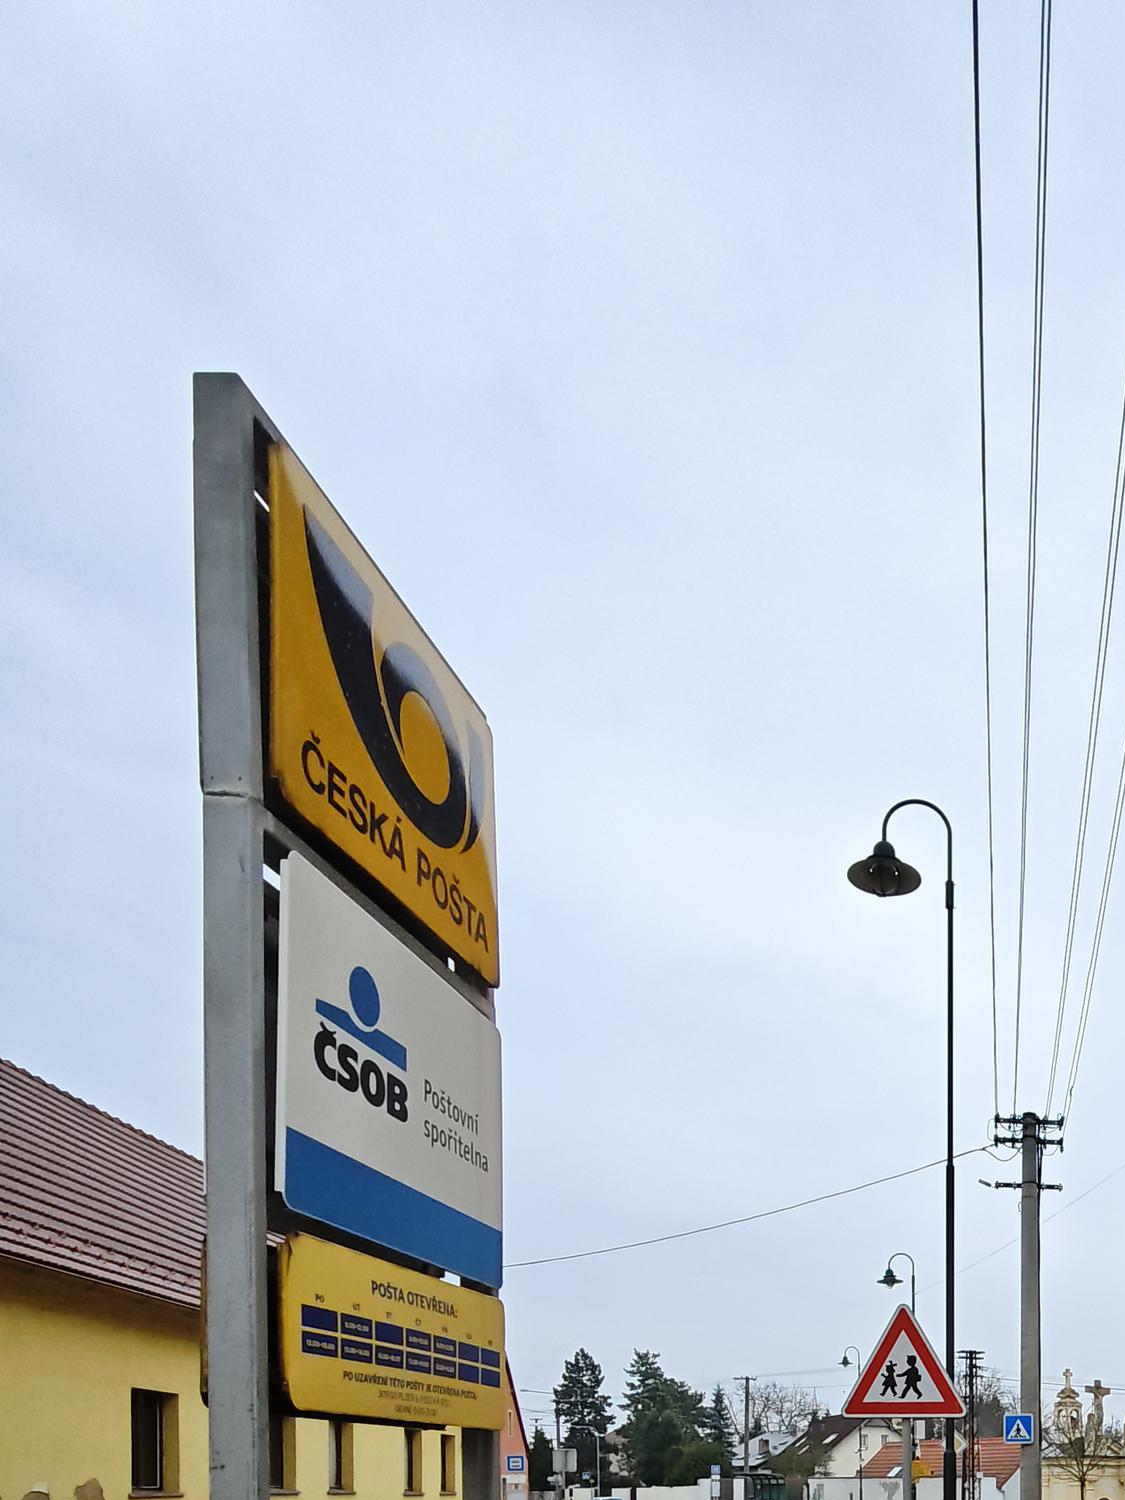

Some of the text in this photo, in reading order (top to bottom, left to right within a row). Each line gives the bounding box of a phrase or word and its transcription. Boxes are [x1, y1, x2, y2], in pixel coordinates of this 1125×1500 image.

[301, 731, 490, 954] ČESKÁ POŠTA
[313, 1021, 409, 1123] ČSOB
[424, 1079, 480, 1136] Poštovní
[423, 1119, 489, 1173] spořitelna
[315, 1293, 325, 1303] PO
[371, 1279, 459, 1319] POŠTA OTEVŘENA:
[343, 1370, 354, 1380] PO
